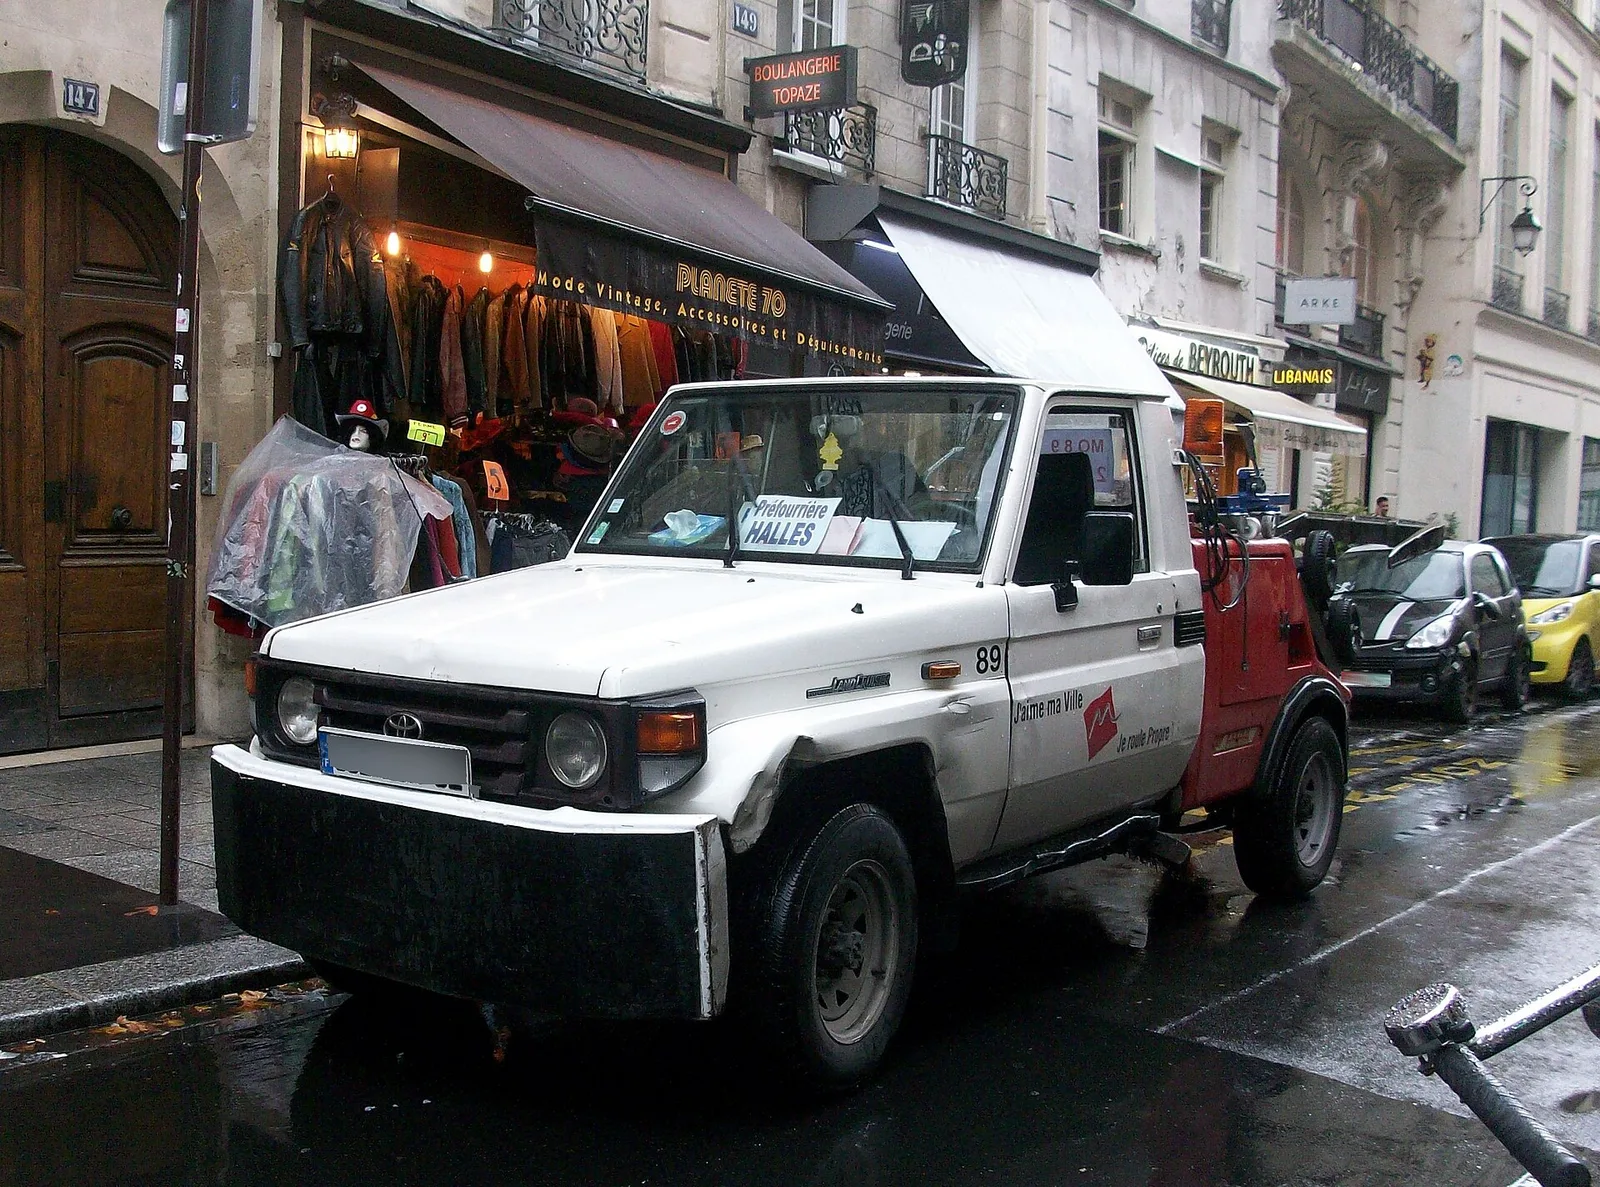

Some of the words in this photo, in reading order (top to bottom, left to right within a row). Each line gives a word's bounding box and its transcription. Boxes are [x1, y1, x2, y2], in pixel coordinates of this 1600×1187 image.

[734, 4, 757, 31] 149
[754, 55, 841, 82] BOULANGERIE
[67, 84, 96, 110] 147
[773, 84, 821, 105] TOPAZE
[676, 263, 757, 312] PLANETE
[761, 286, 787, 318] 70
[1300, 297, 1340, 309] ARKE
[537, 271, 586, 294] Mode
[596, 282, 667, 316] Vintage,
[677, 302, 767, 336] Accessoires
[773, 327, 787, 341] et
[797, 332, 883, 365] Déguisements
[1172, 349, 1184, 368] de
[1188, 342, 1255, 384] BEYROUTH
[1273, 368, 1334, 384] LIBANAIS
[744, 521, 816, 547] HALLES
[976, 644, 1001, 675] 89
[1014, 697, 1045, 724] J'aime
[1047, 698, 1061, 716] ma
[1063, 690, 1083, 712] Ville
[1116, 733, 1126, 753] Je
[1127, 729, 1147, 751] roule
[1146, 726, 1170, 747] Propre
